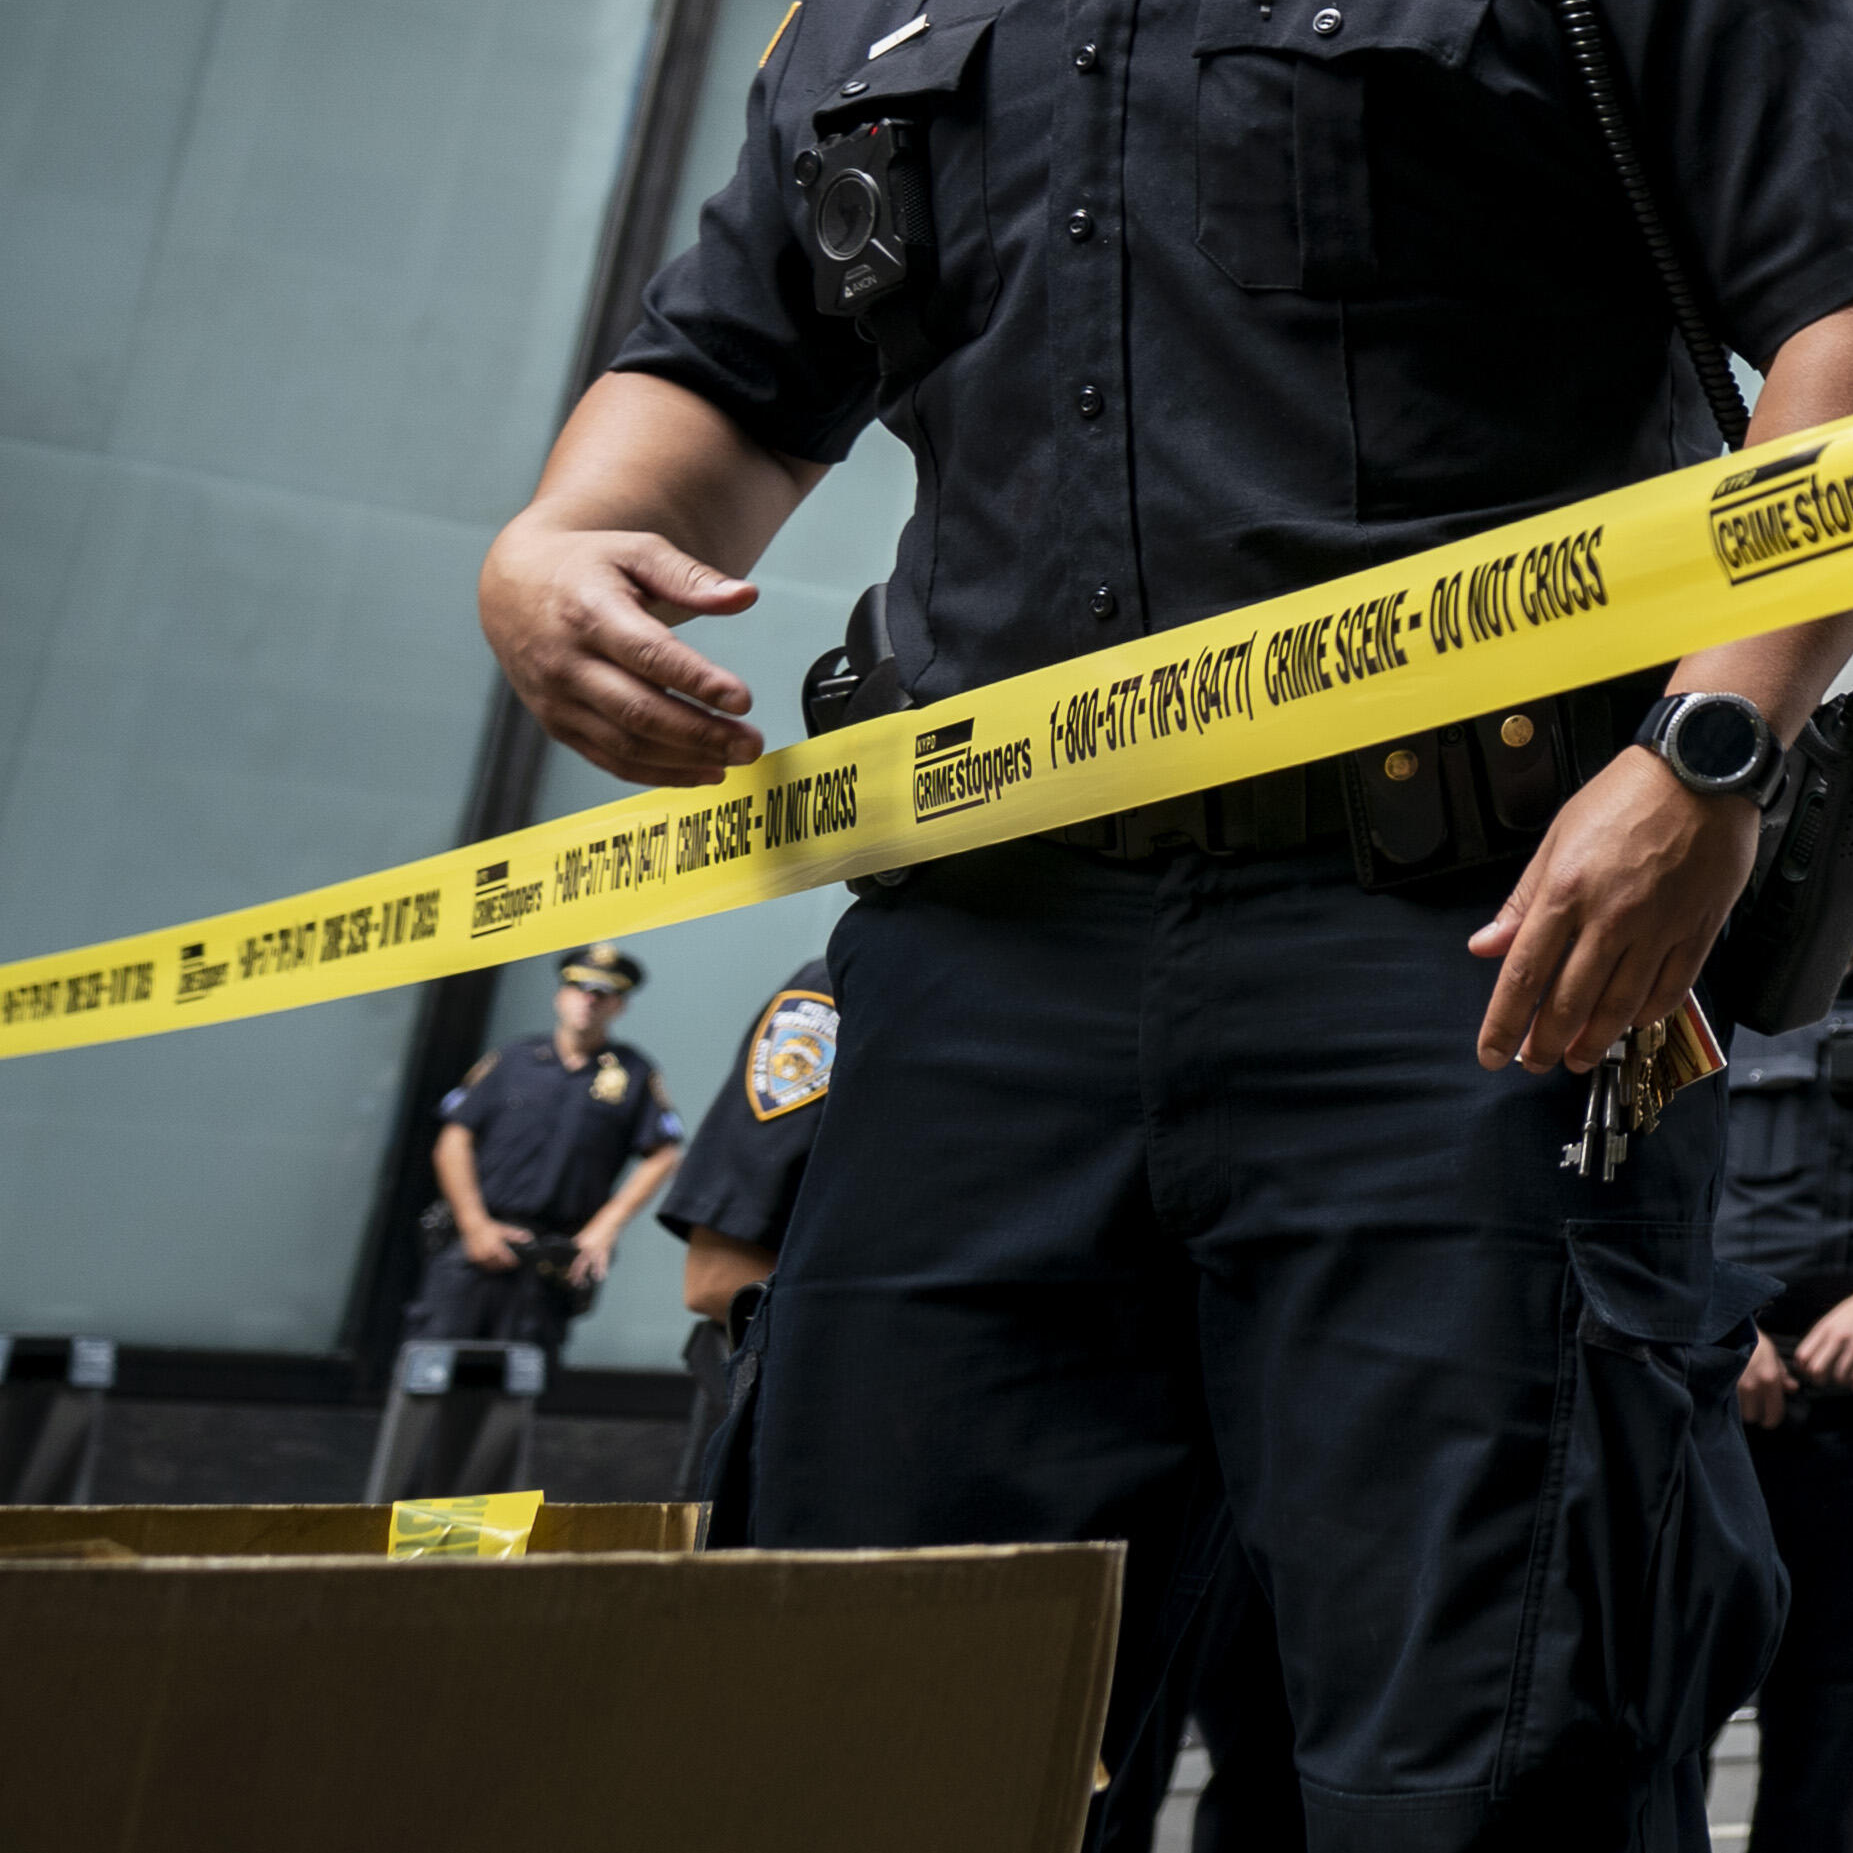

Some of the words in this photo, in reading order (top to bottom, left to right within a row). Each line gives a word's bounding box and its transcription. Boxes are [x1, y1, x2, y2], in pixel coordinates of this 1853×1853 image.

[1049, 657, 1187, 770] 1-800-577-TIPS
[1189, 630, 1258, 735] (8477)
[1263, 614, 1333, 707] CRIME
[1334, 590, 1409, 686] SCENE
[1429, 576, 1465, 654] DO
[1467, 559, 1518, 643] NOT
[1520, 525, 1609, 624] CROSS
[676, 809, 713, 875] CRIME
[713, 795, 753, 864] SCENE
[765, 785, 783, 850] DO
[784, 777, 811, 844] NOT
[813, 763, 858, 837] CROSS
